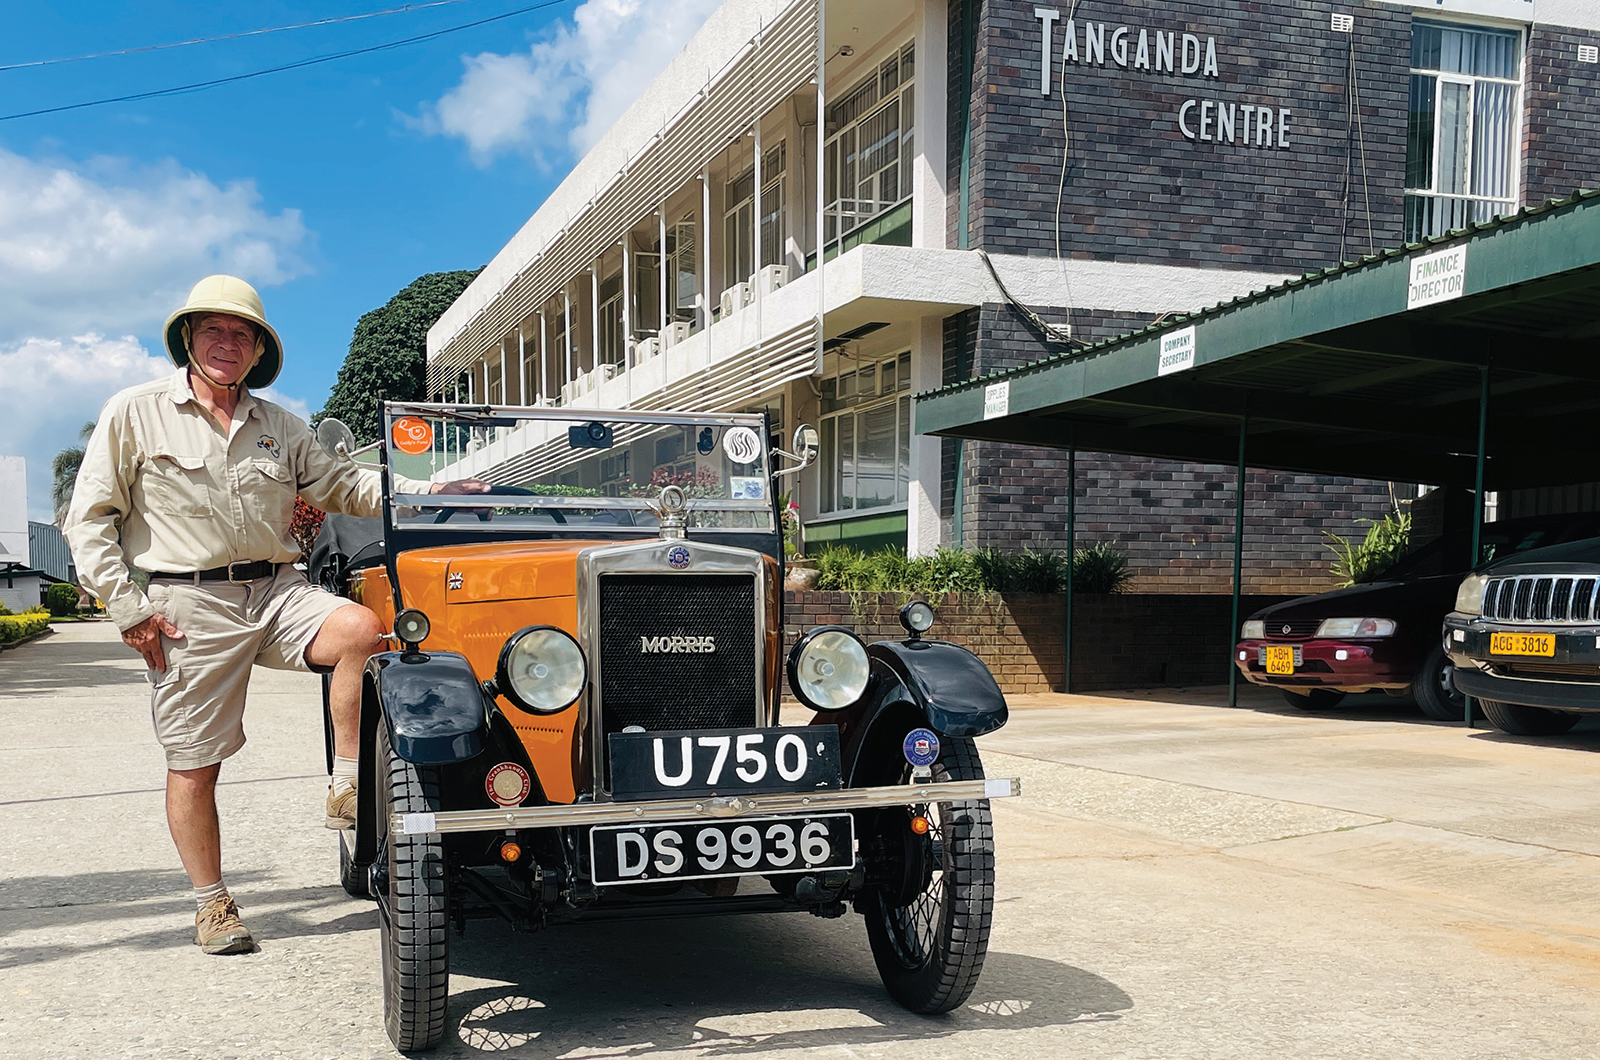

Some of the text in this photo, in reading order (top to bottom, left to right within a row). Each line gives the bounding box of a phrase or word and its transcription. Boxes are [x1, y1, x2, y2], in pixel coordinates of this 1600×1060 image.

[1034, 8, 1219, 96] TANGANDA
[1178, 99, 1291, 148] CENTRE
[1416, 253, 1460, 281] FINANCE
[1411, 274, 1462, 302] DIRECTOR
[1164, 334, 1191, 352] COMPANY
[1161, 349, 1193, 368] SECRETARY
[640, 635, 716, 654] MORRIS
[1273, 648, 1290, 661] ABH
[1492, 636, 1513, 652] ACG
[1520, 636, 1549, 653] 3816
[653, 733, 809, 787] U750
[616, 822, 831, 877] DS 9936
